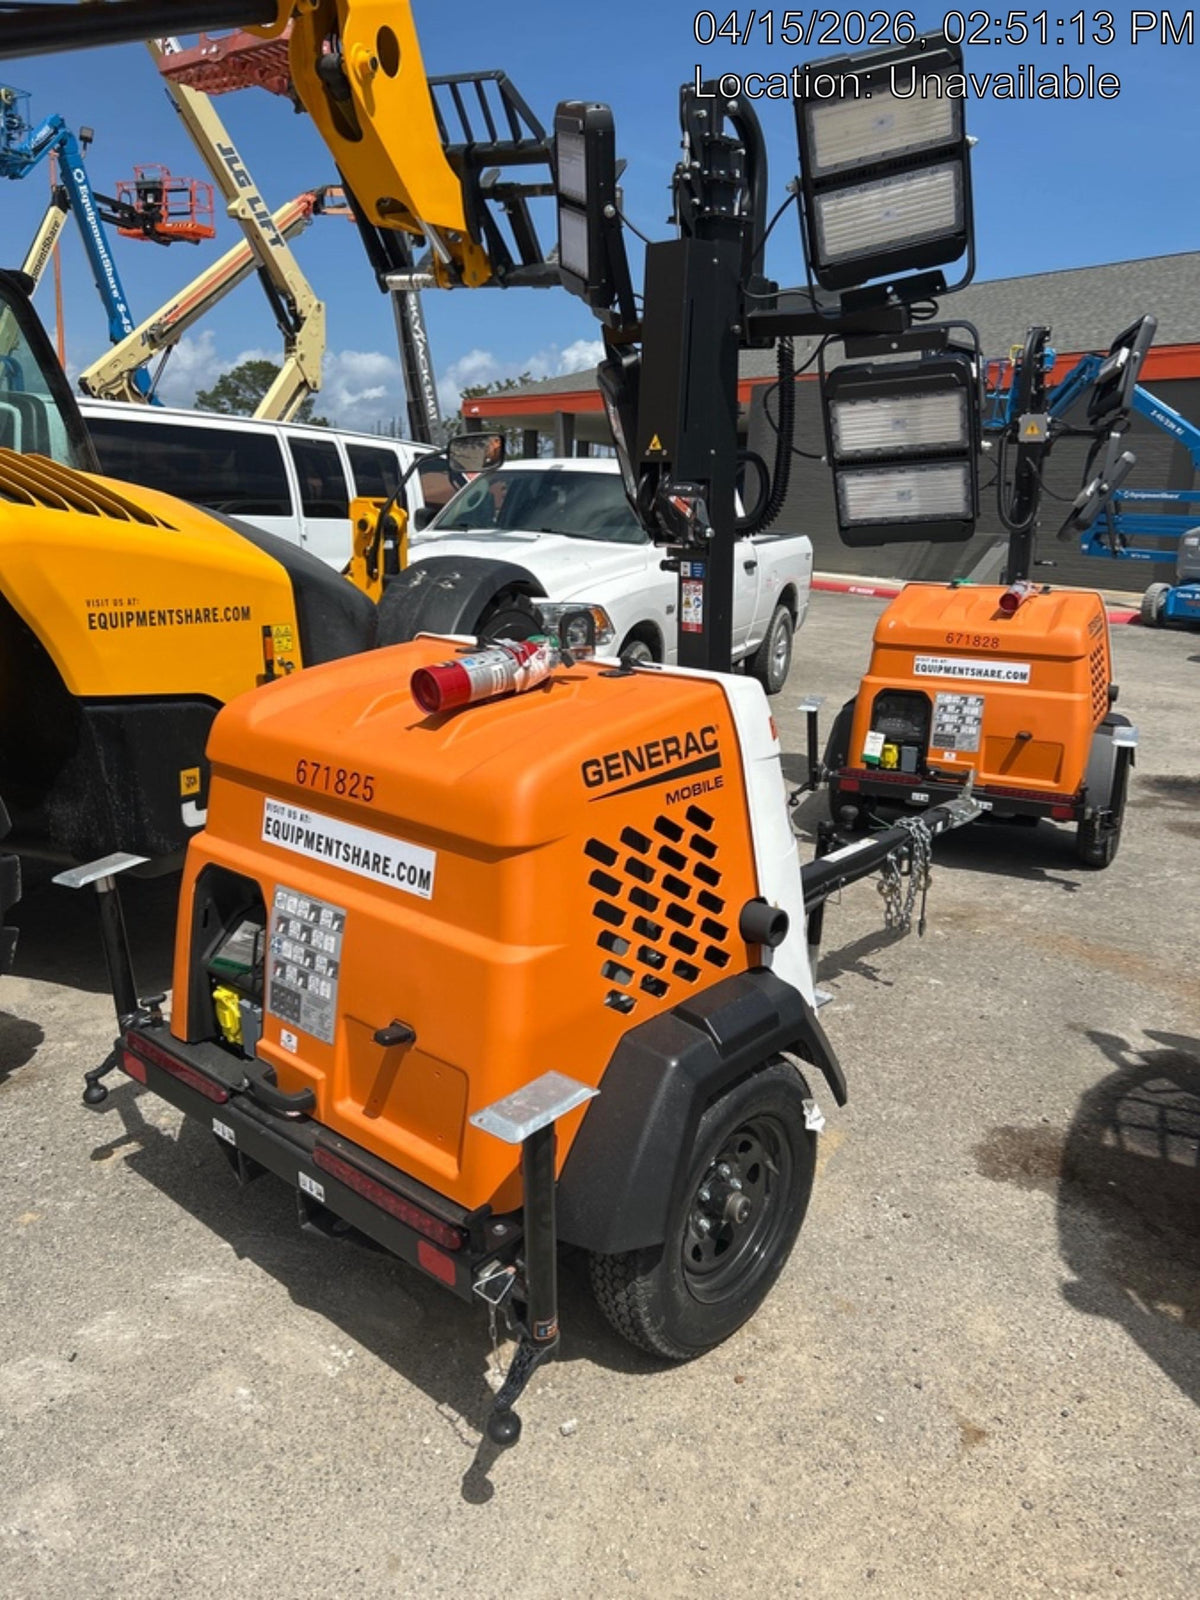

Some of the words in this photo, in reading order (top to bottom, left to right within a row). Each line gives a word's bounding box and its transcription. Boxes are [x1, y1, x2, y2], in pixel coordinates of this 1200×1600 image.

[216, 142, 253, 188] JLG
[246, 196, 286, 247] LIFT
[79, 186, 121, 299] EquipmentShare
[86, 598, 109, 608] VISIT
[113, 598, 124, 607] US
[88, 606, 251, 631] EQUIPMENTSHARE.COM
[946, 632, 1000, 649] 671828
[915, 663, 1029, 681] EQUIPMENTSHARE.COM
[581, 725, 719, 788] GENERAC
[296, 759, 375, 802] 671825
[665, 775, 724, 806] MOBILE
[266, 802, 286, 816] VISIT
[287, 809, 298, 820] US
[265, 817, 431, 892] EQUIPMENTSHARE.COM
